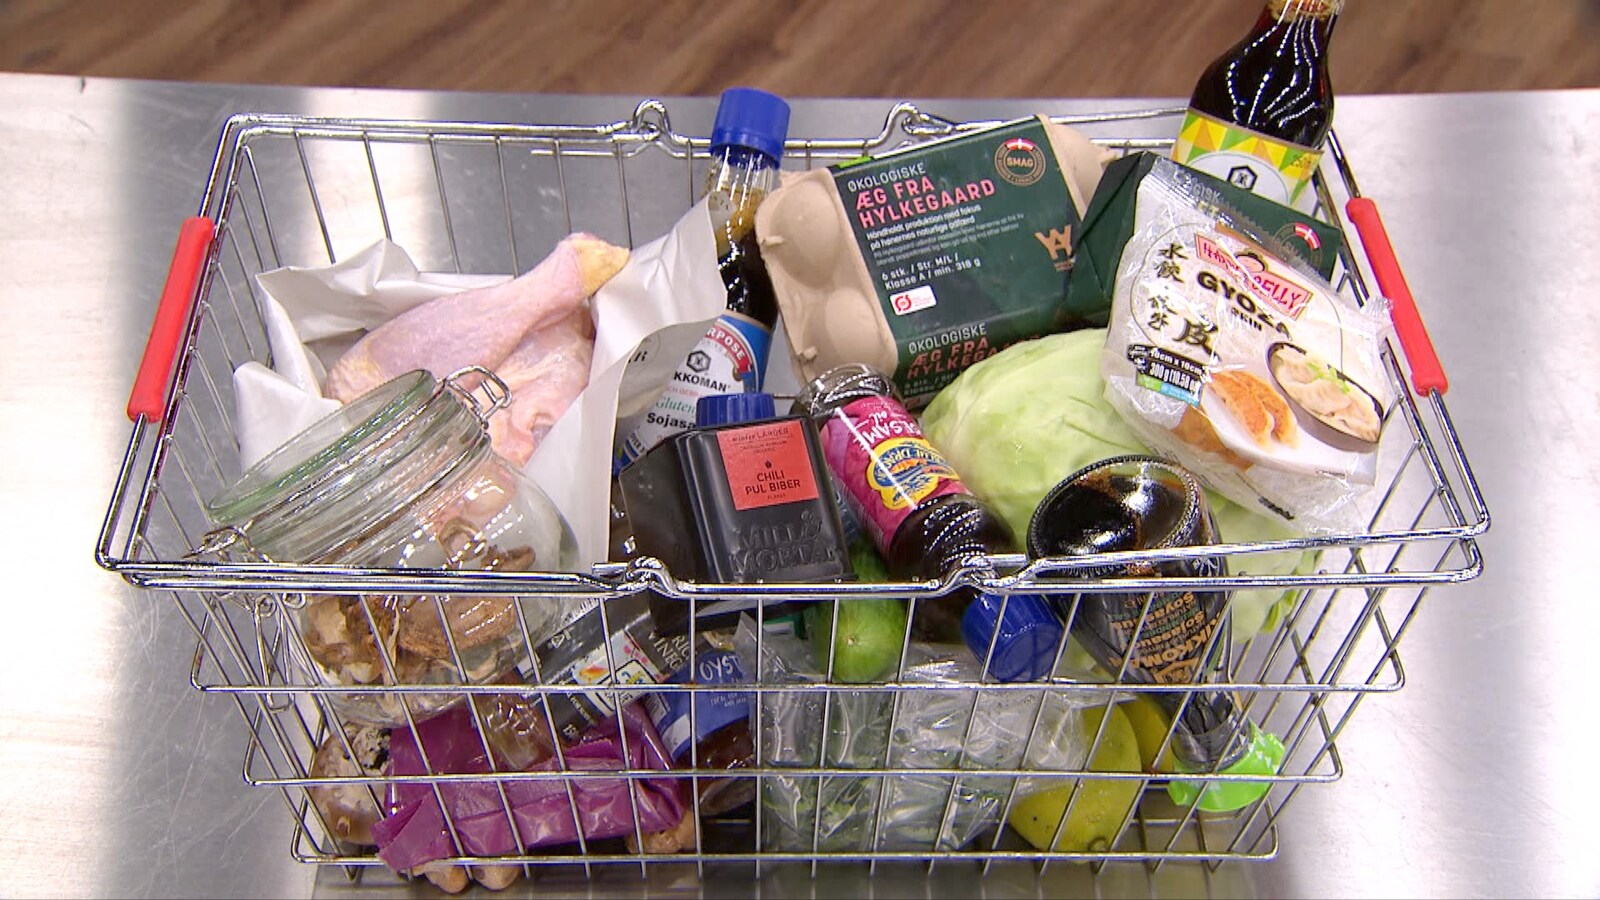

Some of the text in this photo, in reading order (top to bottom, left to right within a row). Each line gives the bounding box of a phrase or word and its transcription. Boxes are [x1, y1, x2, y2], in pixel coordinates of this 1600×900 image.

[1007, 157, 1033, 168] SMAG
[847, 162, 926, 192] ØKOLOGISKE
[856, 176, 935, 211] ÆG FRA
[859, 178, 995, 229] HYLKEGAARD
[905, 214, 944, 231] produktion
[944, 210, 960, 221] med
[960, 204, 982, 217] fokus
[916, 223, 949, 238] naturlige
[882, 272, 889, 281] 6
[890, 267, 909, 279] stk.
[917, 261, 934, 272] Str.
[935, 255, 953, 267] M/L
[885, 274, 917, 291] Klasse
[919, 272, 926, 282] A
[934, 265, 954, 277] min.
[973, 257, 981, 267] g
[1197, 270, 1292, 341] GYOZA
[1231, 306, 1262, 332] SKIN
[706, 326, 745, 361] RPOSE
[908, 322, 987, 354] ØKOLOGISKE
[907, 342, 1005, 379] HYLKEGA
[913, 336, 989, 368] ÆG FRA
[1150, 347, 1174, 364] 10cm
[673, 371, 728, 393] KKOMAN
[1150, 362, 1164, 379] 300
[655, 395, 697, 414] Gluten
[646, 412, 697, 431] Sojasa
[868, 410, 888, 430] oil
[745, 479, 801, 496] PUL BIBER
[756, 469, 786, 482] CHILI
[649, 632, 684, 670] VINEG
[672, 635, 690, 661] RIC
[1108, 611, 1222, 669] IKKOMAN
[699, 655, 744, 683] OYST
